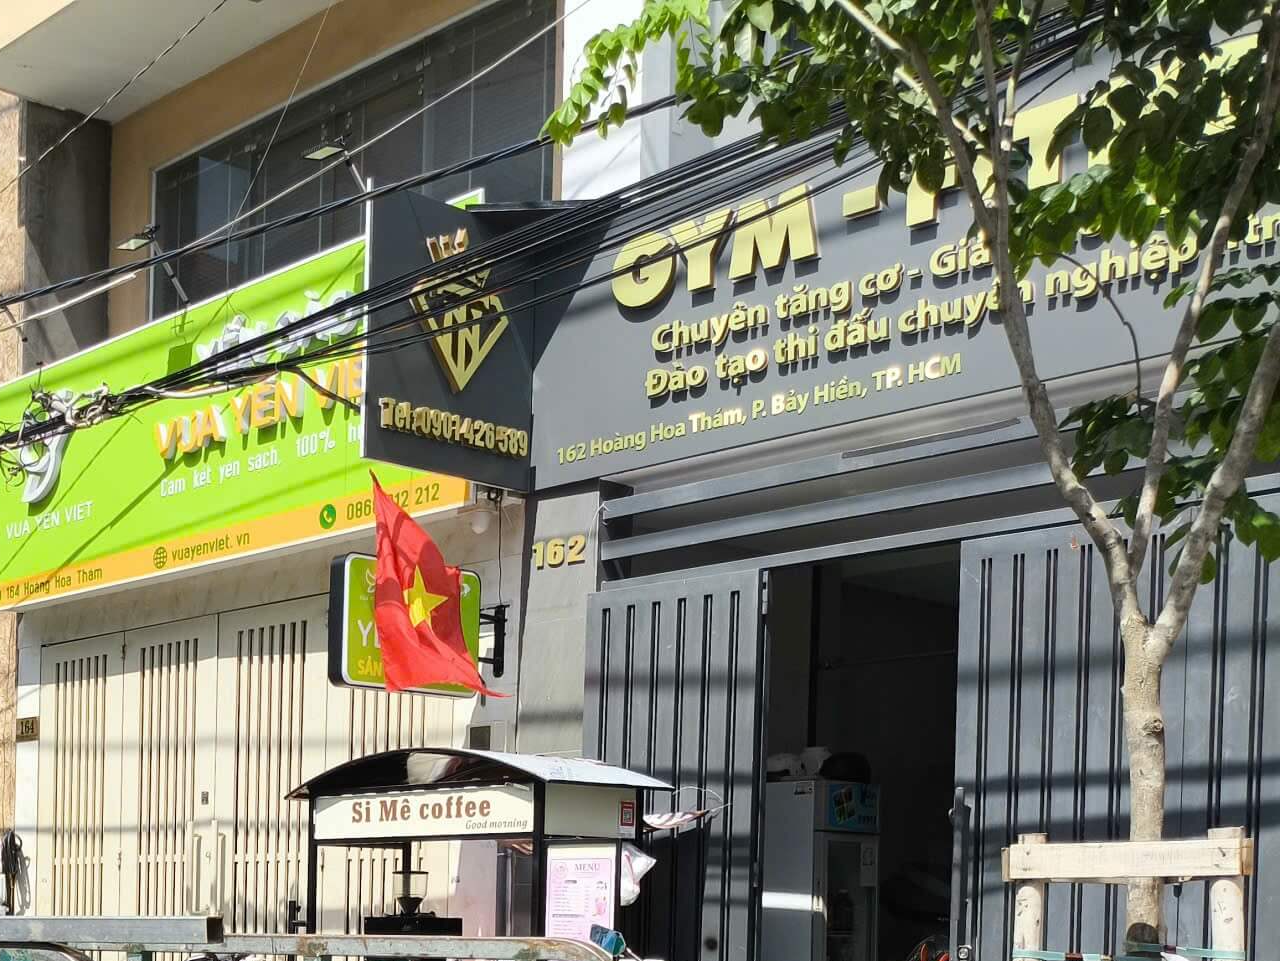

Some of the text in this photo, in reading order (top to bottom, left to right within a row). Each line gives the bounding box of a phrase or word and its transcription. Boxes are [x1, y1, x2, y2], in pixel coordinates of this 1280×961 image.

[611, 183, 821, 309] GYM
[650, 300, 769, 353] Chuyên
[775, 278, 853, 318] tăng
[858, 264, 904, 298] cơ
[644, 360, 710, 400] Đào
[715, 347, 768, 386] tạo
[773, 325, 818, 364] thi
[824, 307, 890, 354] đấu
[155, 404, 227, 459] VUA
[296, 428, 336, 458] 100%
[556, 441, 586, 466] 162
[590, 429, 647, 459] Hoàng
[650, 419, 686, 445] Hoa
[751, 400, 767, 420] P.
[770, 388, 809, 418] Bảy
[415, 482, 440, 505] 212
[6, 500, 94, 540] VUA YEN VIET
[531, 534, 586, 571] 162
[20, 719, 34, 735] 164
[351, 795, 491, 824] Si Mê coffee
[574, 863, 600, 872] MENU
